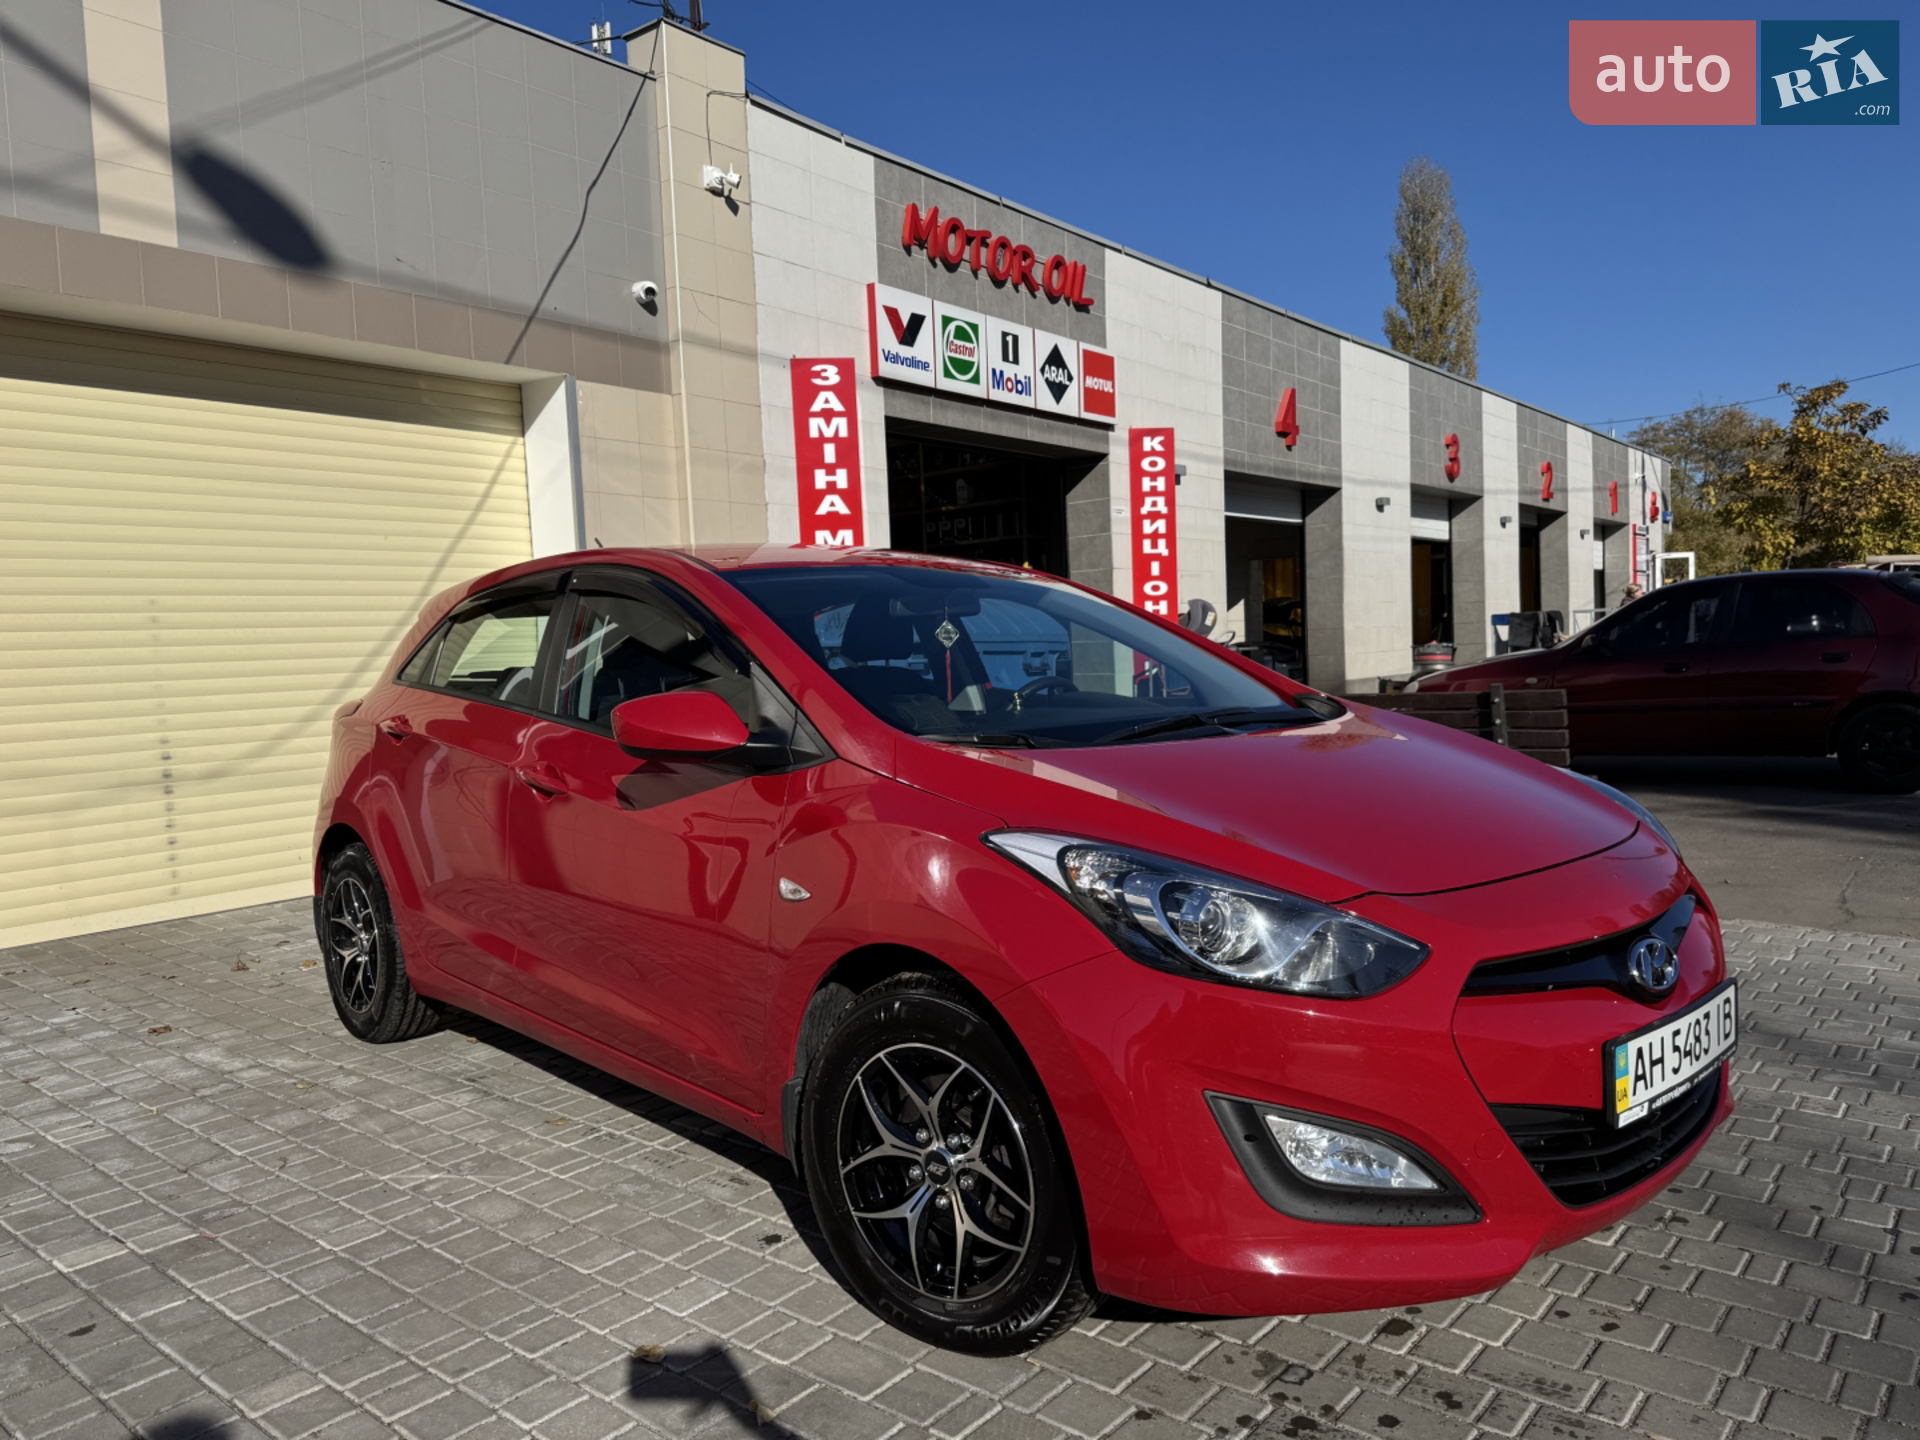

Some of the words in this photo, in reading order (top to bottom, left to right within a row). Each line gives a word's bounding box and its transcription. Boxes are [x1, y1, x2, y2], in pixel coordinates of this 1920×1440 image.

[902, 202, 1040, 292] MOTOR
[1043, 254, 1095, 306] OIL
[881, 348, 931, 373] Valvoline
[948, 339, 976, 359] Castrol
[991, 367, 1032, 397] Mobil
[1043, 363, 1071, 384] ARAL
[1085, 375, 1114, 393] MOTUL
[1274, 387, 1300, 446] 4
[808, 364, 851, 516] ЗАМІНА
[1444, 433, 1461, 480] 3
[1540, 461, 1555, 500] 2
[1608, 481, 1618, 514] 1
[1632, 1036, 1665, 1098] AH
[1671, 1010, 1711, 1076] 5483
[1717, 996, 1733, 1047] IB
[1616, 1087, 1629, 1103] UA
